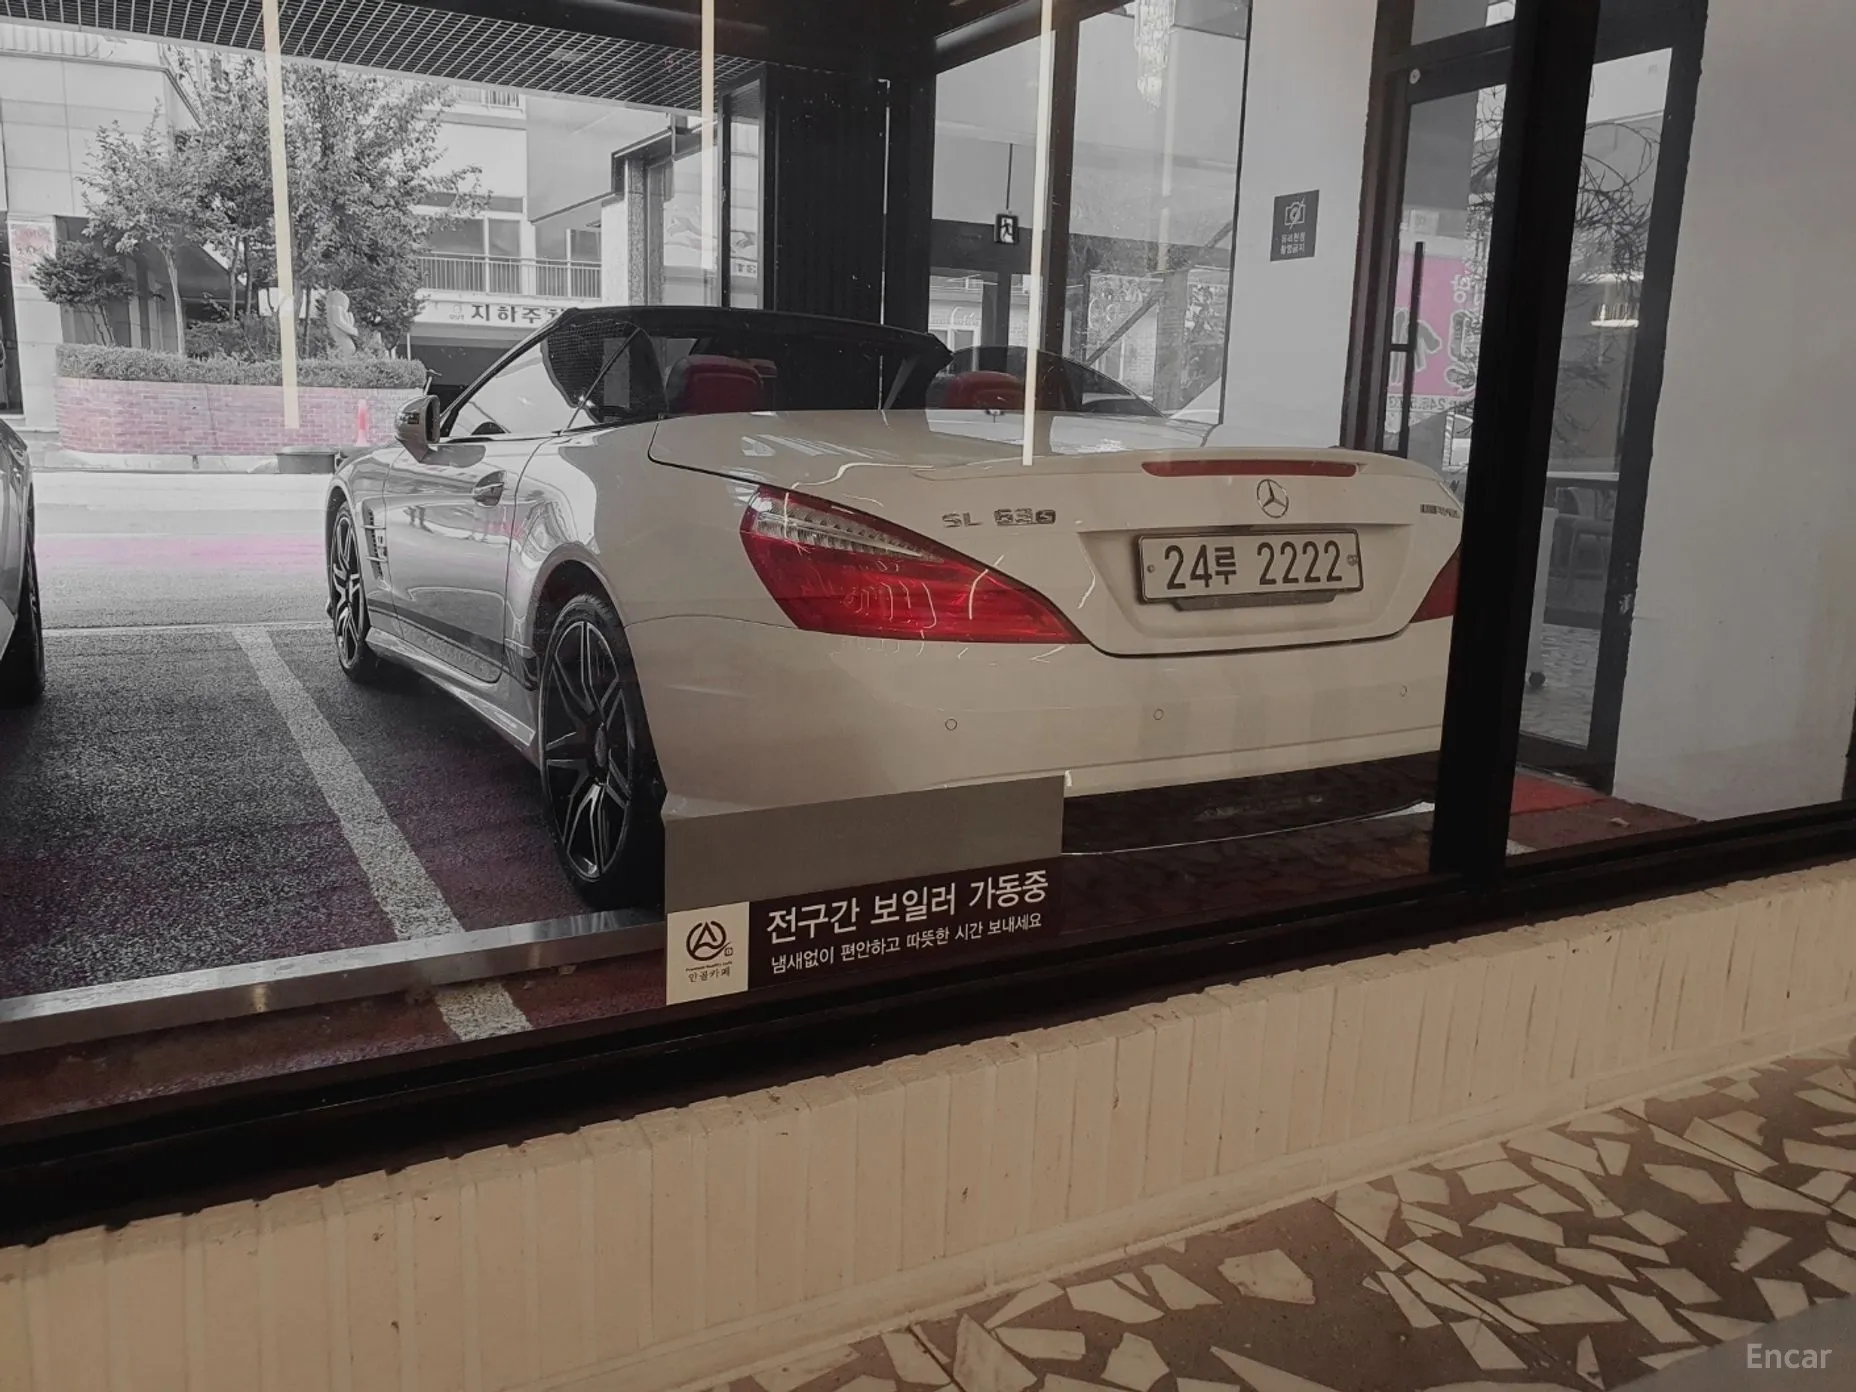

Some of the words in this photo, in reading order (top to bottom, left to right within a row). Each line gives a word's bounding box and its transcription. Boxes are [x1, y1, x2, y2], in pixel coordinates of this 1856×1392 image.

[942, 511, 981, 528] SL
[1164, 544, 1237, 590] 24루
[1257, 540, 1343, 586] 2222
[766, 898, 860, 944] 전구간
[870, 882, 956, 925] 보일러
[967, 869, 1049, 911] 가동중
[771, 946, 835, 975] 냄새없이
[840, 937, 901, 963] 편안하고
[906, 926, 951, 950] 따뜻한
[954, 920, 984, 942] 시간
[987, 912, 1042, 937] 보내세요
